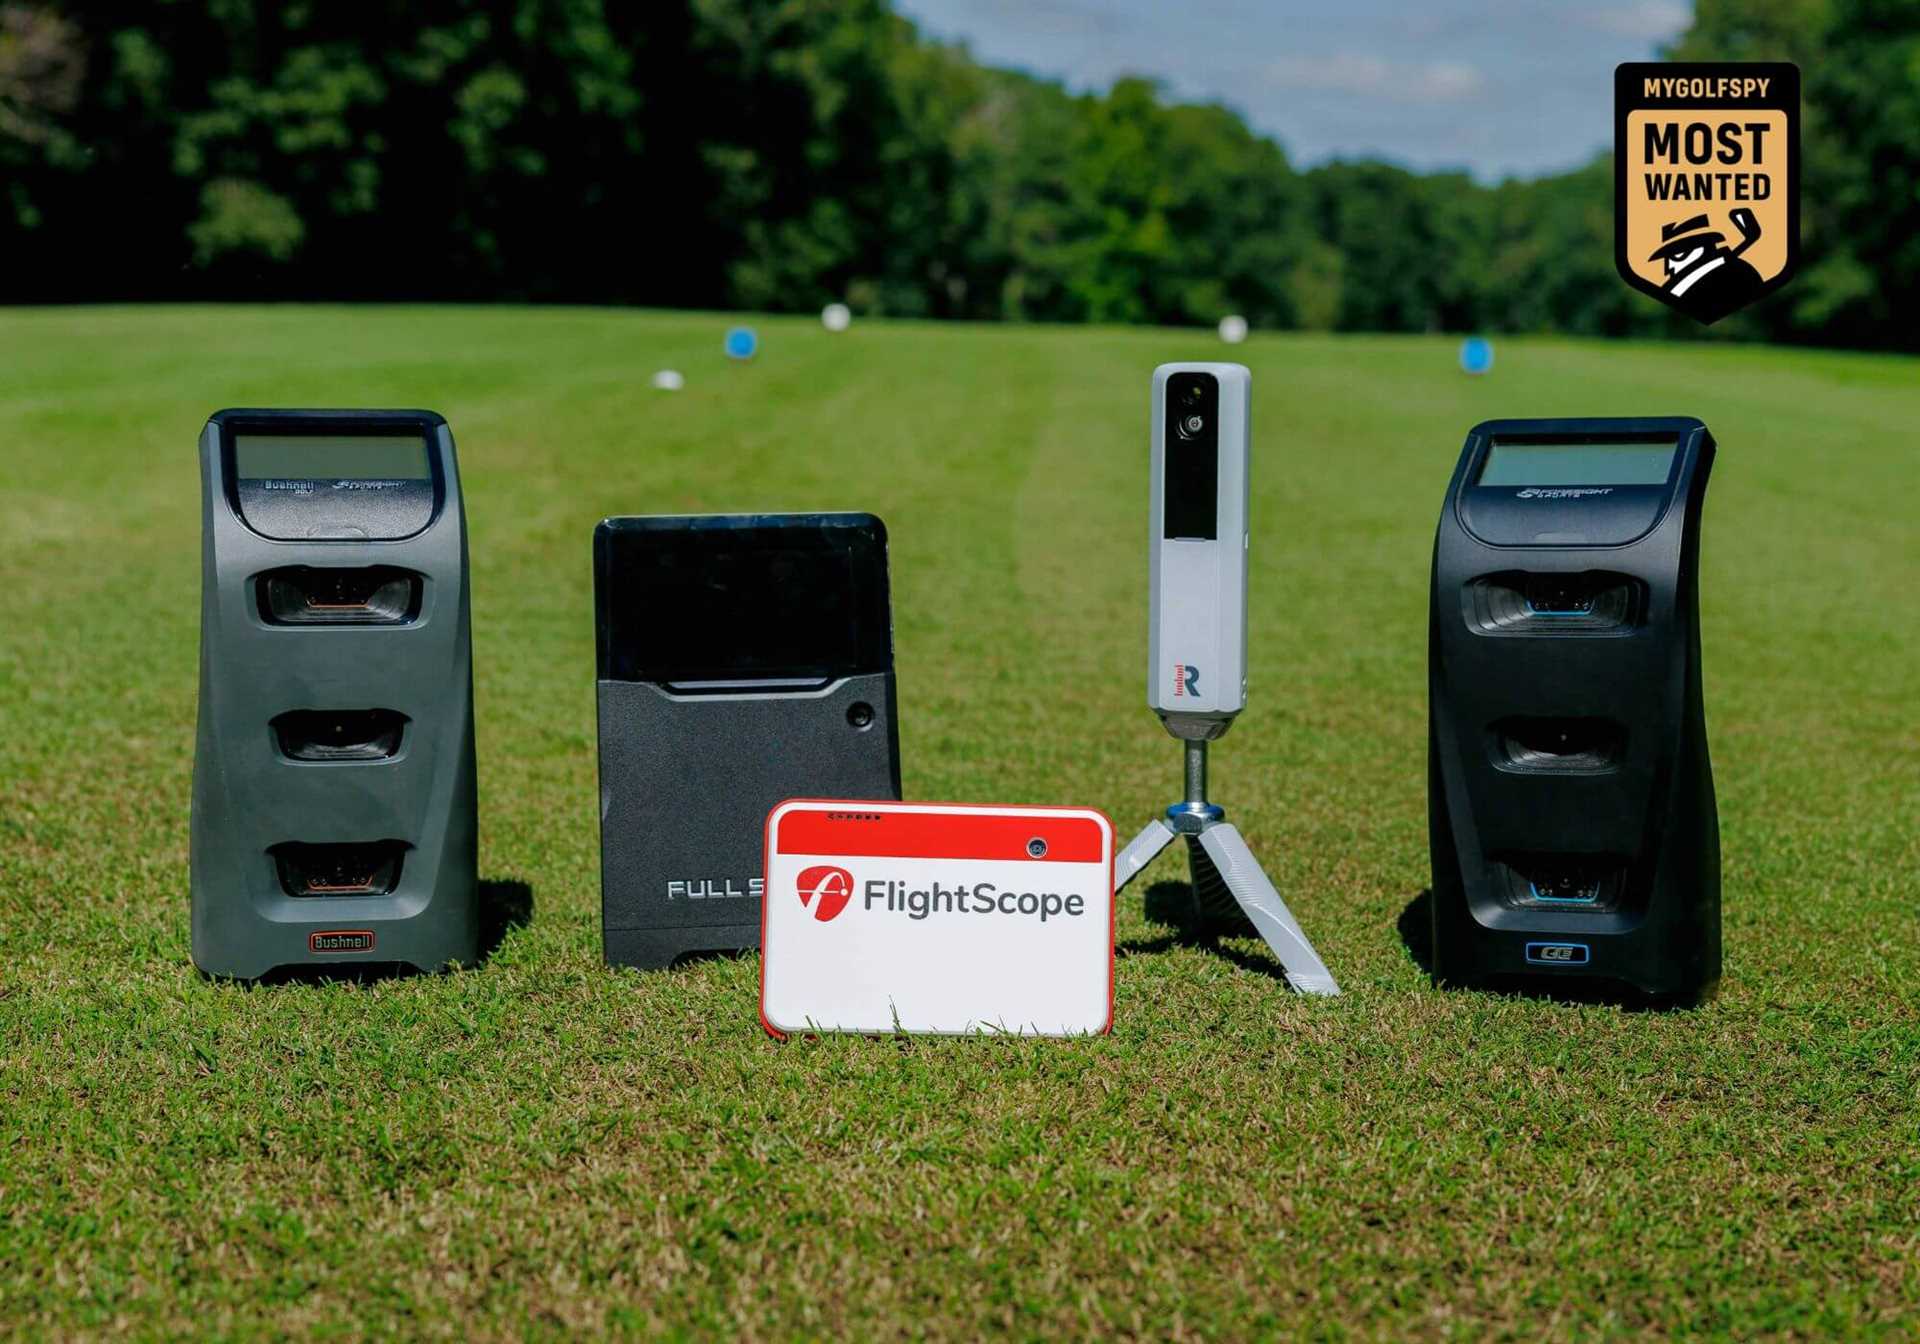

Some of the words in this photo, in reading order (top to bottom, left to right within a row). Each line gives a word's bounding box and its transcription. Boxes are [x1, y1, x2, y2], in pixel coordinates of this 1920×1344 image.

[667, 879, 743, 899] FULL
[864, 880, 1085, 922] FlightScope
[315, 935, 370, 949] Bushnell
